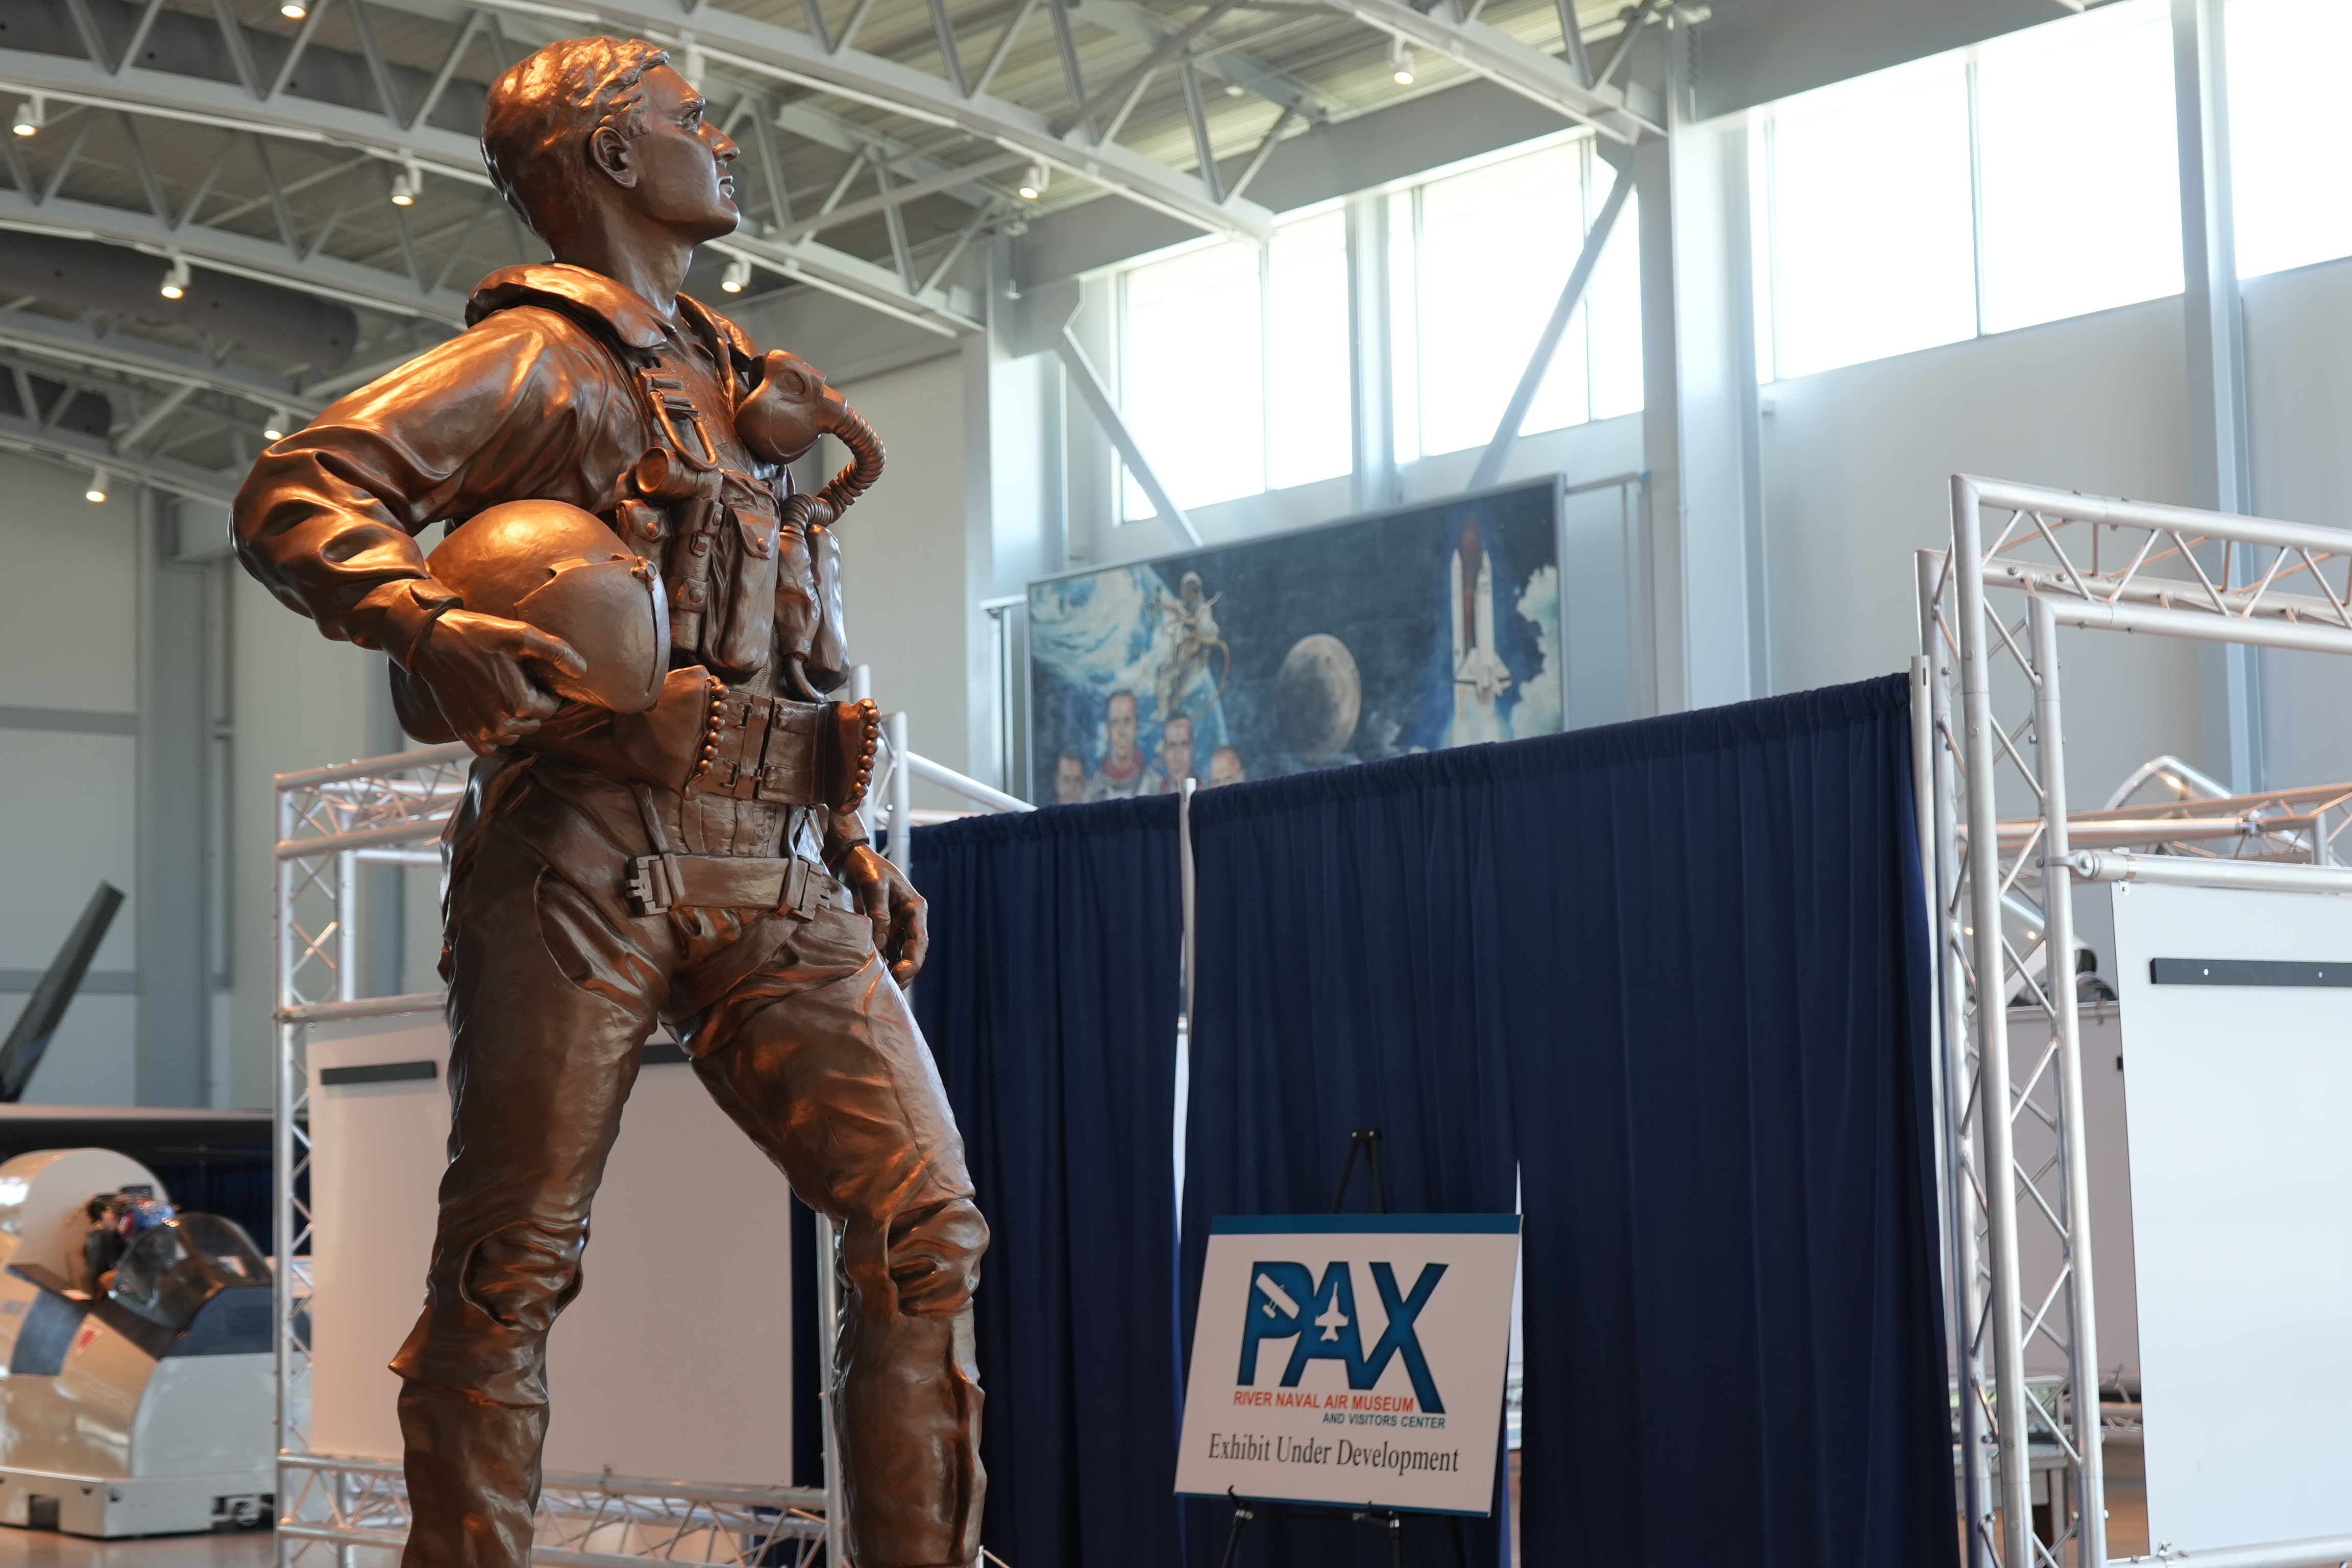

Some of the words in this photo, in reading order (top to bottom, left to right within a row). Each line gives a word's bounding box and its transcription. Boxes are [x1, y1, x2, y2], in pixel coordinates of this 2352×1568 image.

[1237, 1261, 1449, 1414] PAX
[1234, 1391, 1272, 1406] RIVER
[1276, 1392, 1320, 1409] NAVAL
[1325, 1394, 1348, 1409] AIR
[1352, 1395, 1414, 1412] MUSEUM
[1322, 1413, 1344, 1425] AND
[1349, 1414, 1397, 1427] VISITORS
[1401, 1416, 1446, 1429] CENTER
[1208, 1433, 1271, 1461] Exhibit
[1277, 1436, 1331, 1464] Under
[1337, 1439, 1459, 1475] Development
